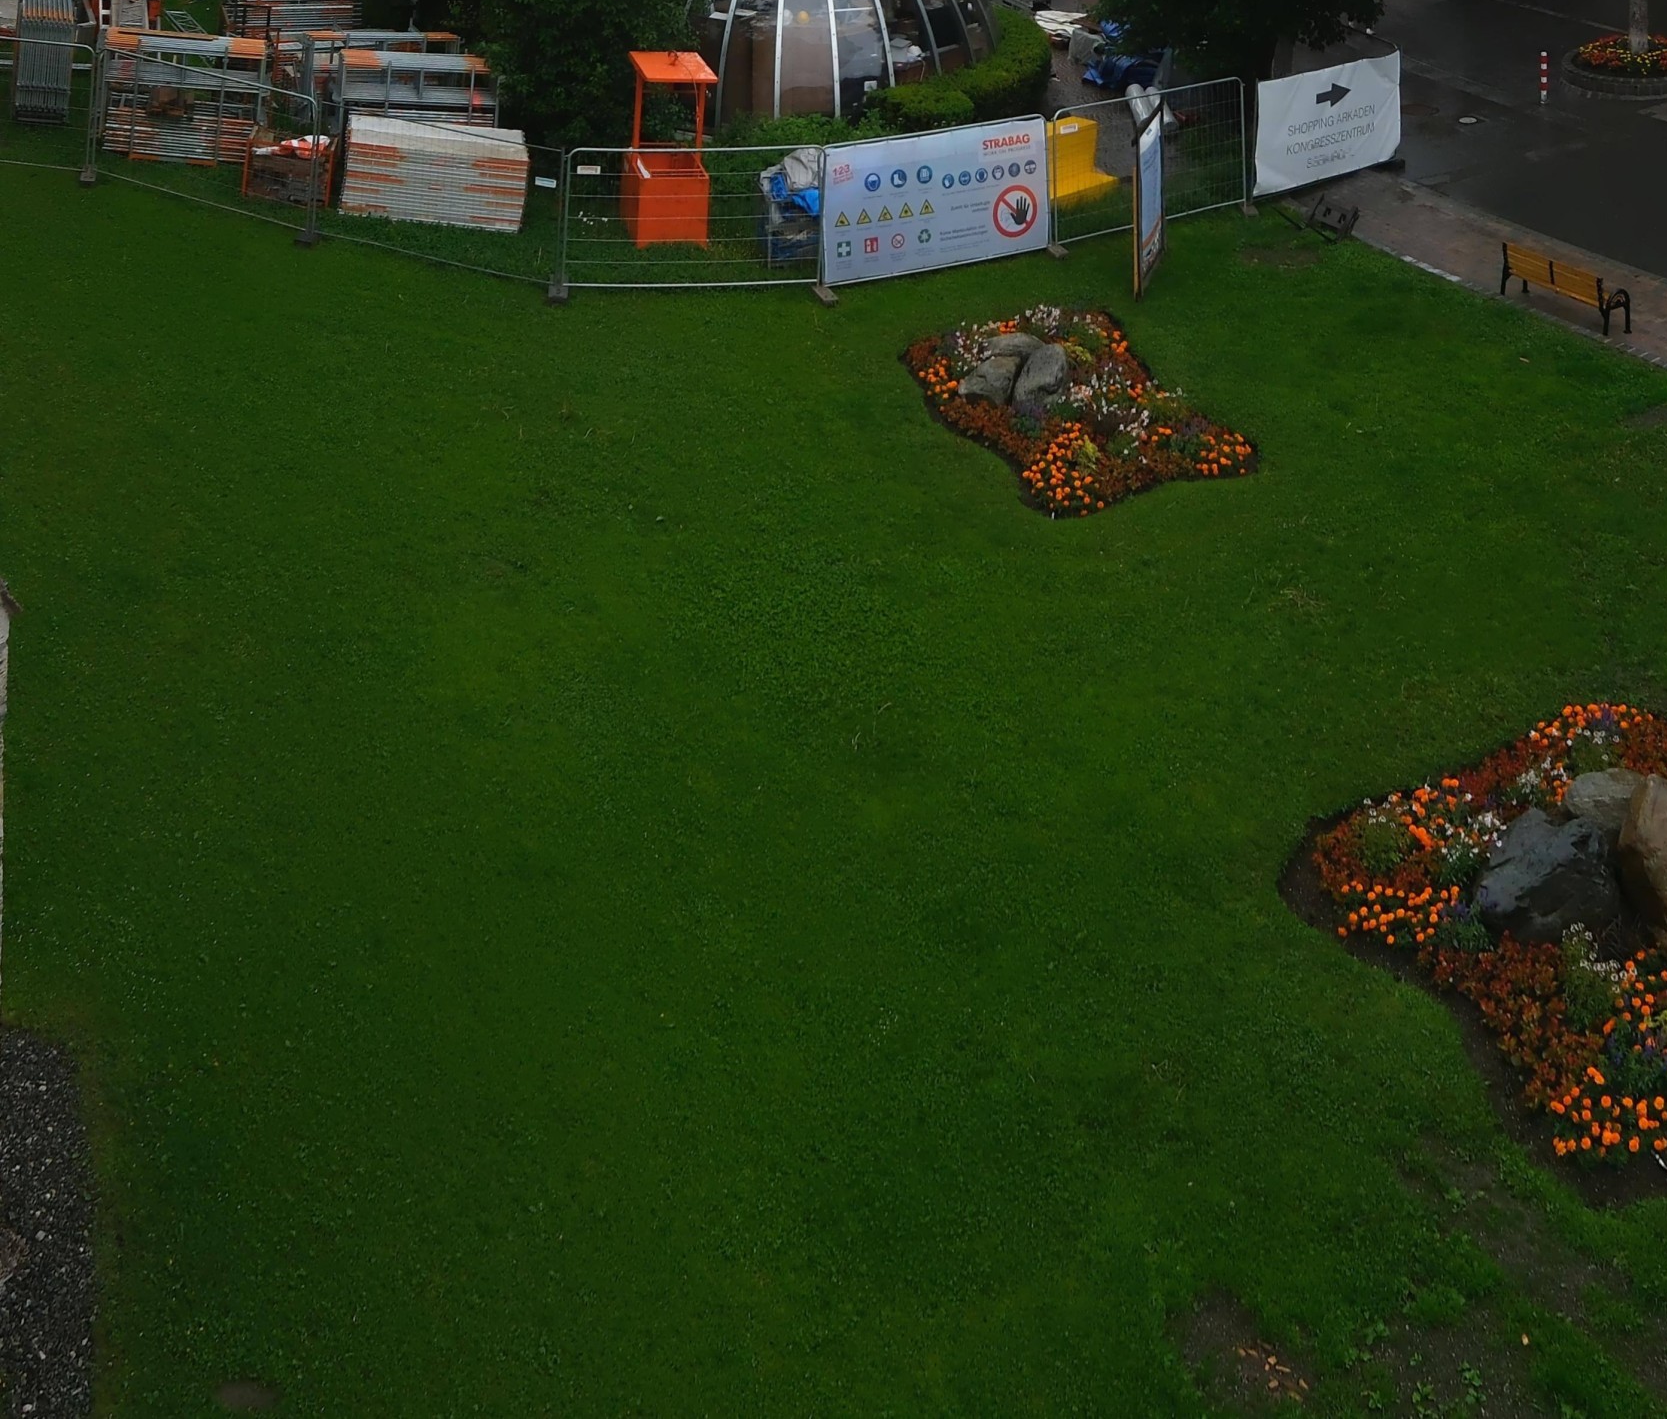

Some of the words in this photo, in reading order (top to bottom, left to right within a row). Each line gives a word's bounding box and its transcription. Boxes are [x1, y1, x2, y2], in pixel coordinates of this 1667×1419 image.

[1287, 117, 1335, 138] SHOPPING
[1336, 104, 1375, 124] ARKADEN
[982, 133, 1030, 150] STRABAG
[1286, 122, 1375, 156] KONGRESSZENTRUM
